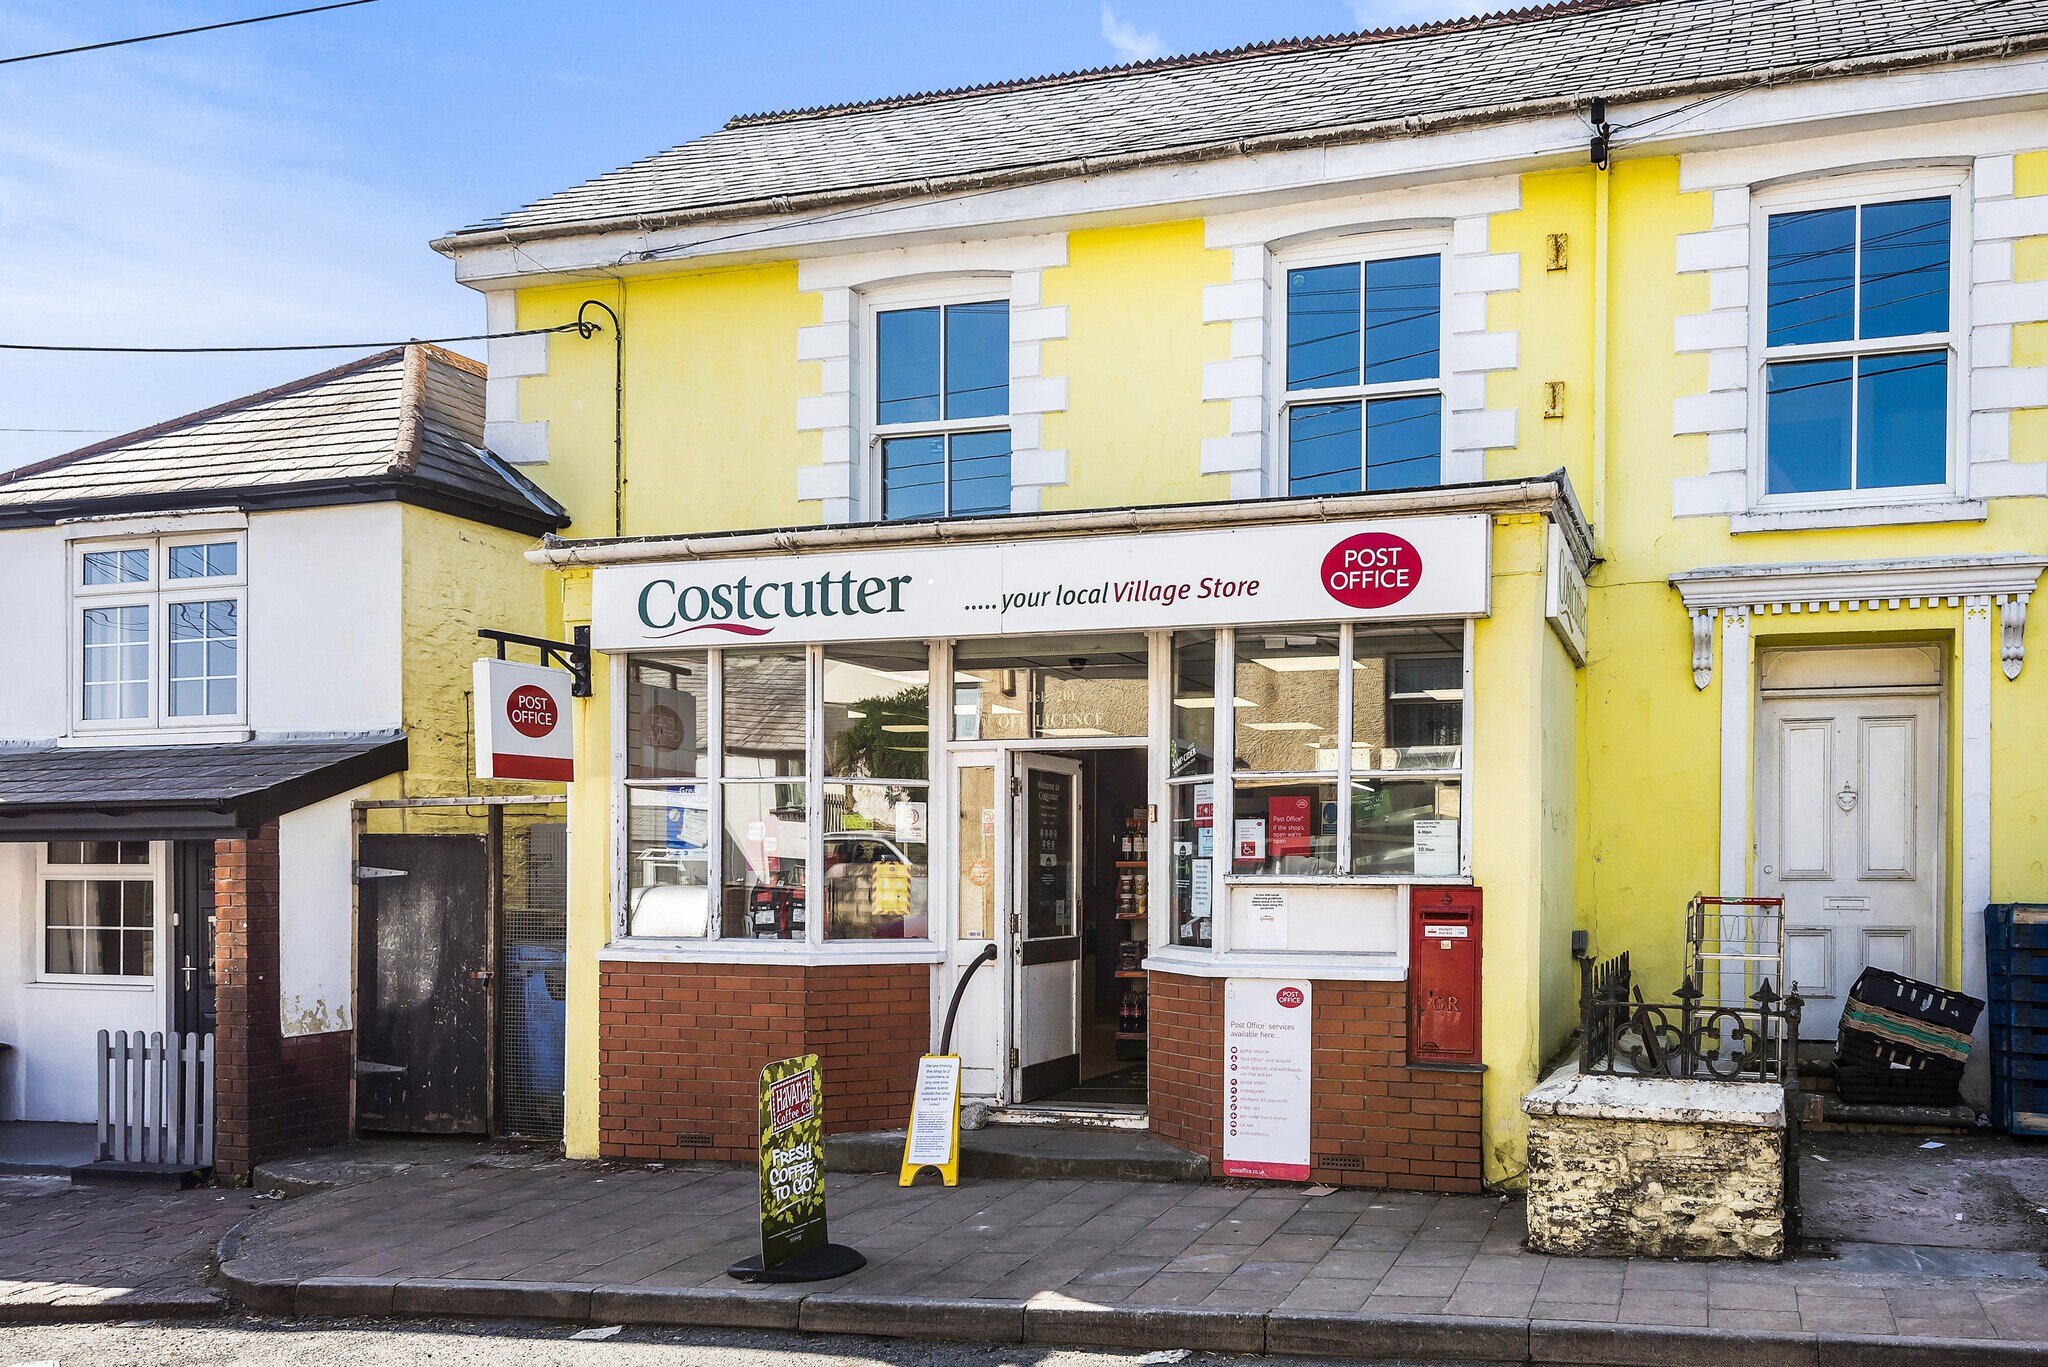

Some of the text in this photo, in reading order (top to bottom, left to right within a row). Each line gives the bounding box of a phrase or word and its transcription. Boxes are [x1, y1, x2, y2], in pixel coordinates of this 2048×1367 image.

[1344, 547, 1403, 568] POST
[1329, 568, 1410, 591] OFFICE
[637, 570, 913, 629] Costcutter
[1055, 582, 1109, 606] local
[1113, 579, 1191, 607] Village
[1197, 576, 1261, 600] Store
[518, 694, 548, 710] POST
[512, 709, 553, 726] OFFICE
[1035, 712, 1105, 729] LICENCE
[1278, 996, 1301, 1004] OFFICE
[1282, 990, 1299, 998] POST
[1230, 1021, 1245, 1029] Post
[1268, 1023, 1295, 1031] services
[776, 1108, 800, 1125] Coffee
[771, 1142, 812, 1168] FRESH
[769, 1160, 815, 1186] COFFEE
[1229, 1167, 1265, 1175] postoffice.co.uk
[772, 1167, 818, 1203] TO GO!
